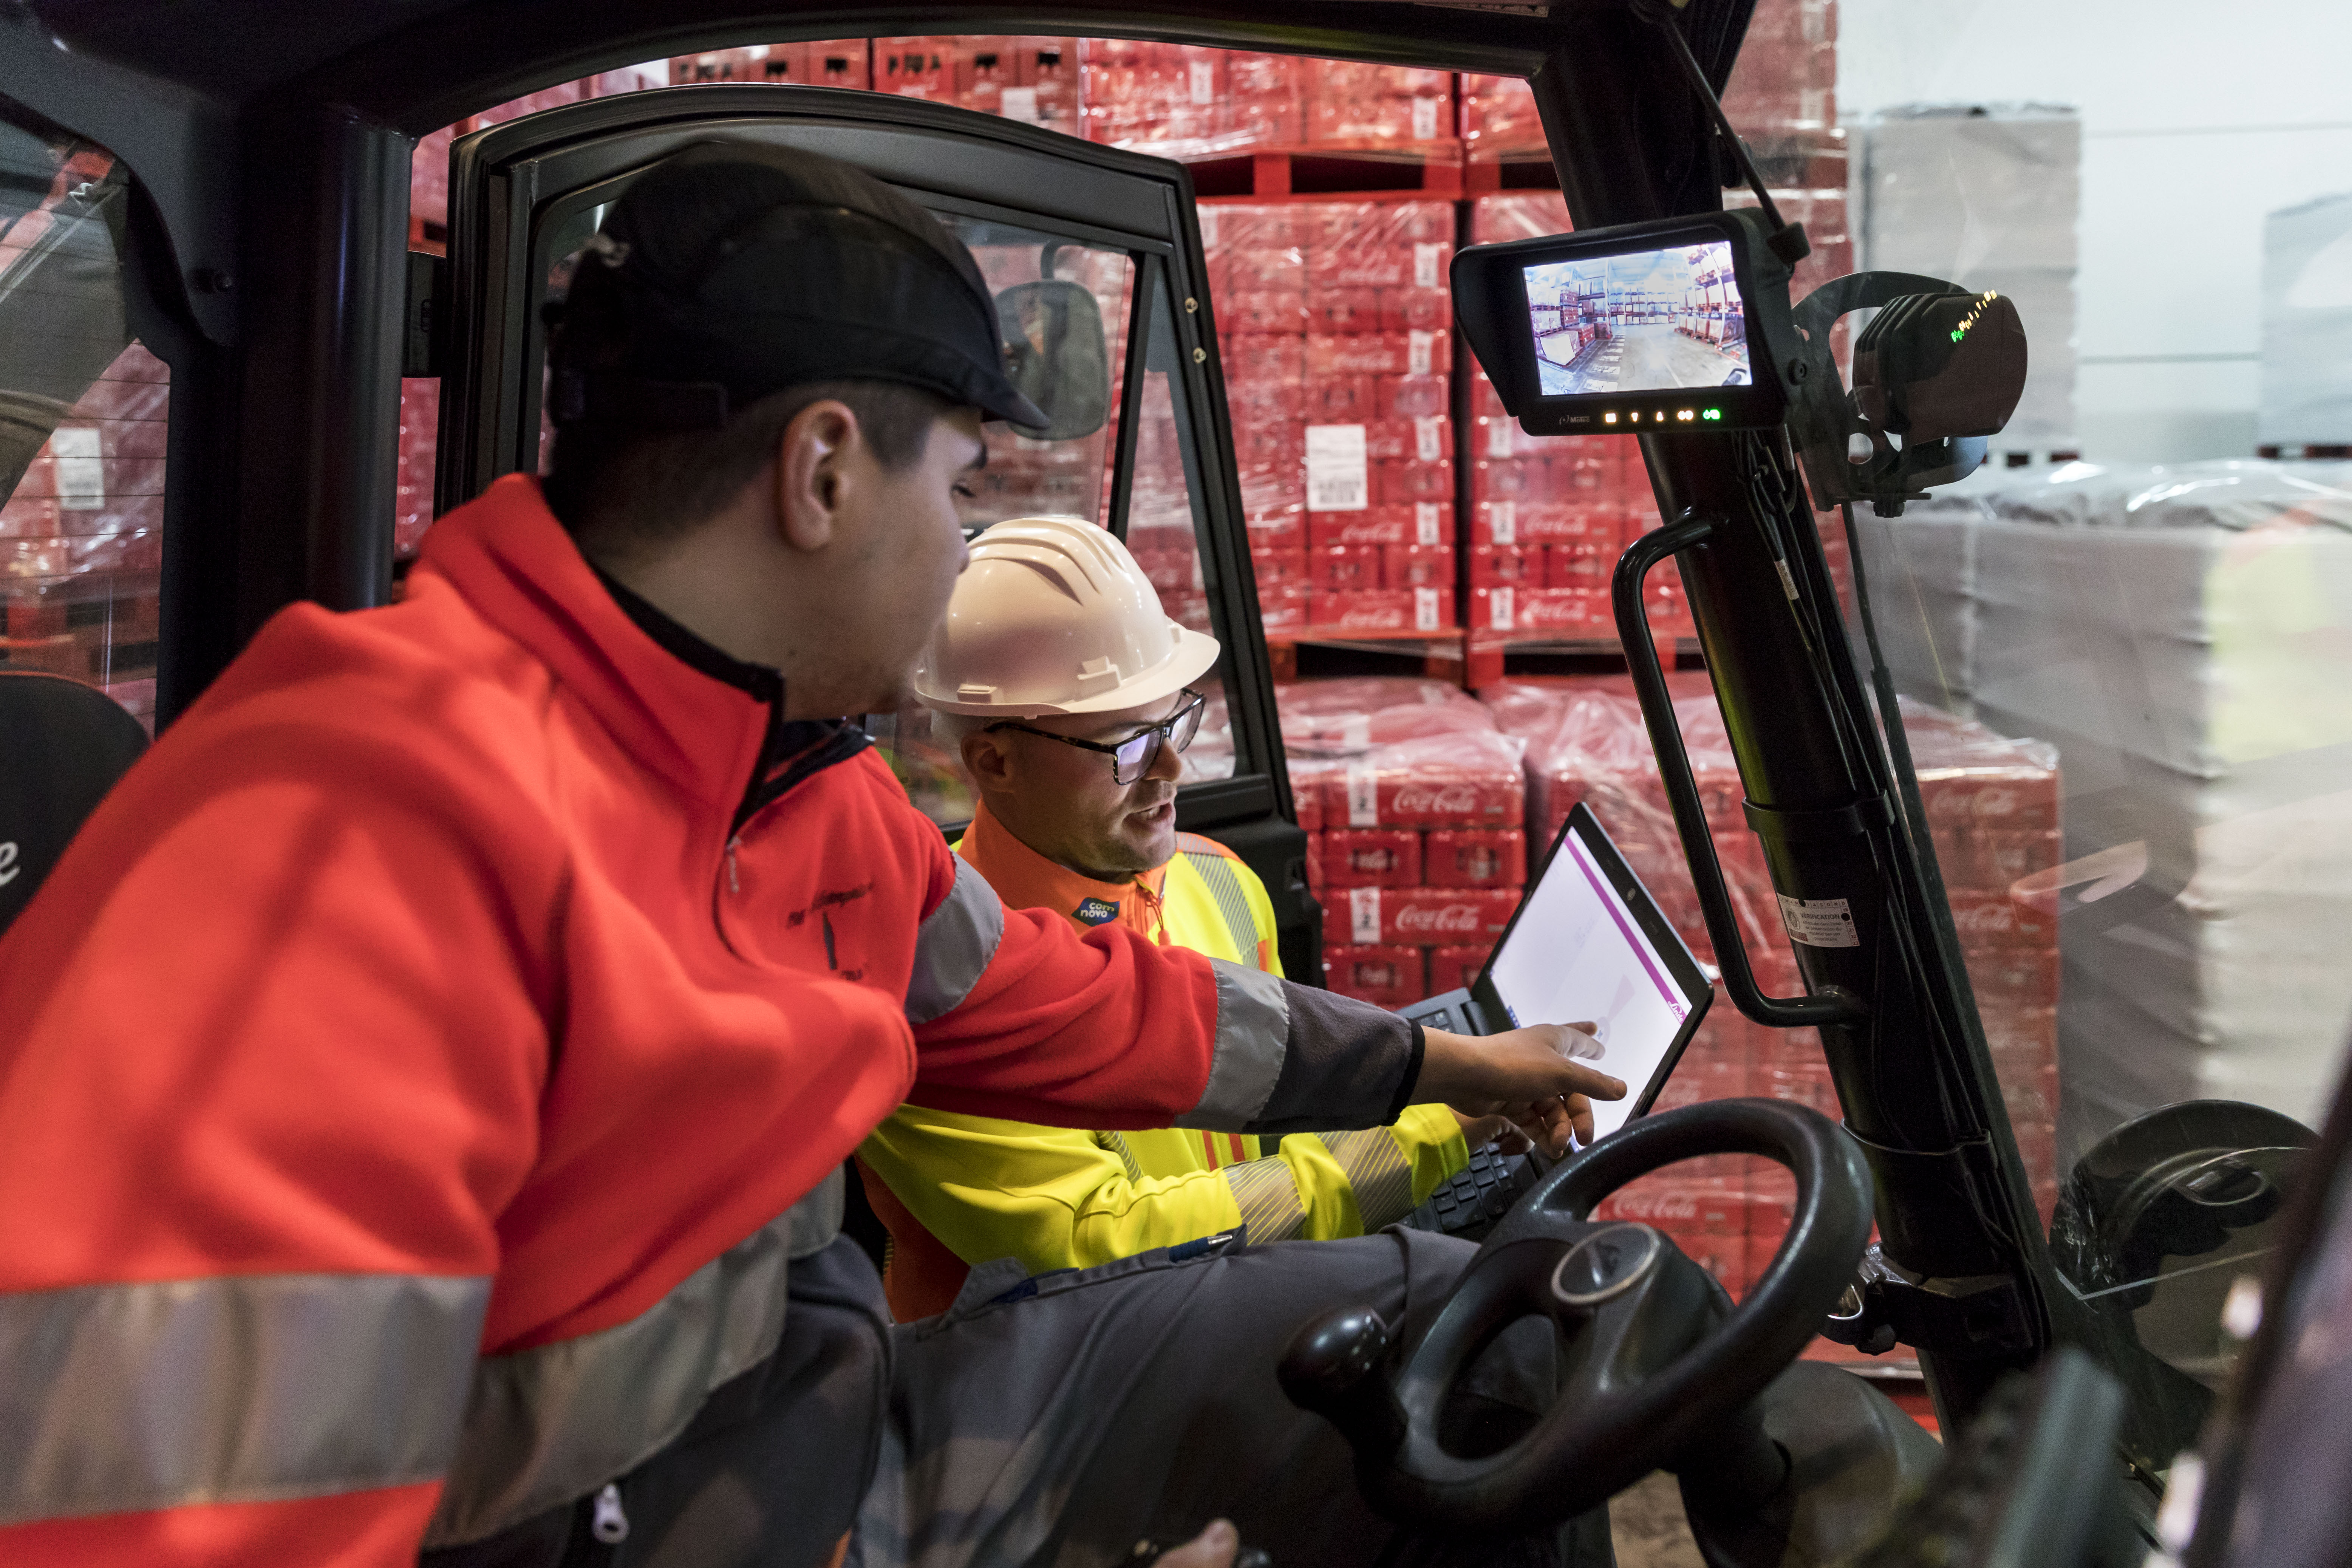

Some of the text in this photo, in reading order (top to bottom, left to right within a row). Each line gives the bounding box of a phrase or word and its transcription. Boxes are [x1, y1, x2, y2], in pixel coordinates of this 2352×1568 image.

[1393, 786, 1478, 813] Coca-Cola
[1081, 909, 1107, 918] novo
[1089, 902, 1115, 911] com
[1396, 904, 1479, 931] Coca-Cola
[1668, 1001, 1683, 1023] Linde
